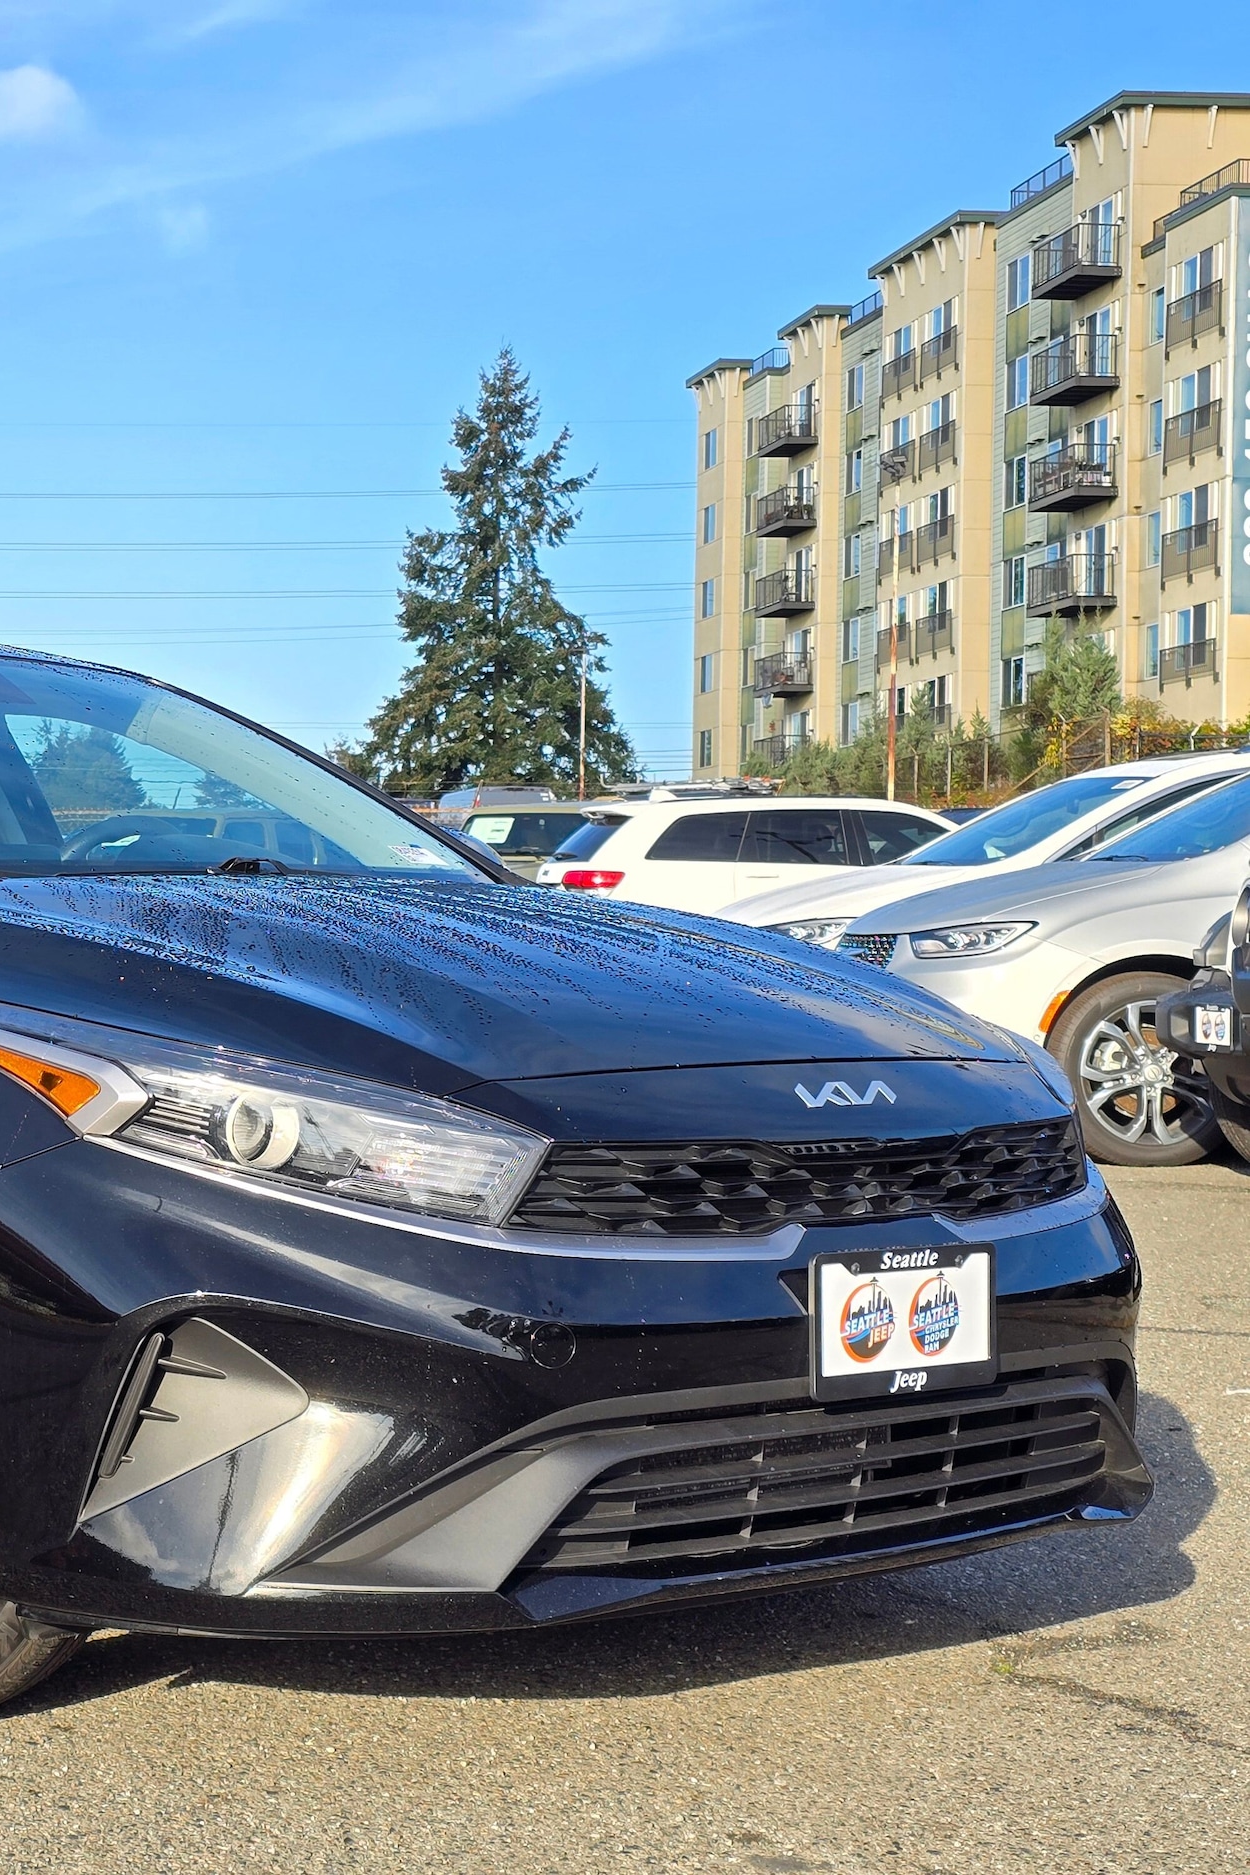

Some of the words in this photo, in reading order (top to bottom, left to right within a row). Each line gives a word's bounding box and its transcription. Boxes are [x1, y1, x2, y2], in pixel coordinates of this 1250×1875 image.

[794, 1080, 897, 1108] KIA
[880, 1249, 939, 1270] Seattle
[844, 1308, 891, 1336] SEATTLE
[912, 1302, 956, 1328] SEATTLE
[924, 1316, 960, 1335] CHRYSLER
[868, 1322, 896, 1348] JEEP
[924, 1328, 950, 1345] DODGE
[924, 1341, 940, 1355] RAM
[889, 1370, 928, 1394] Jeep
